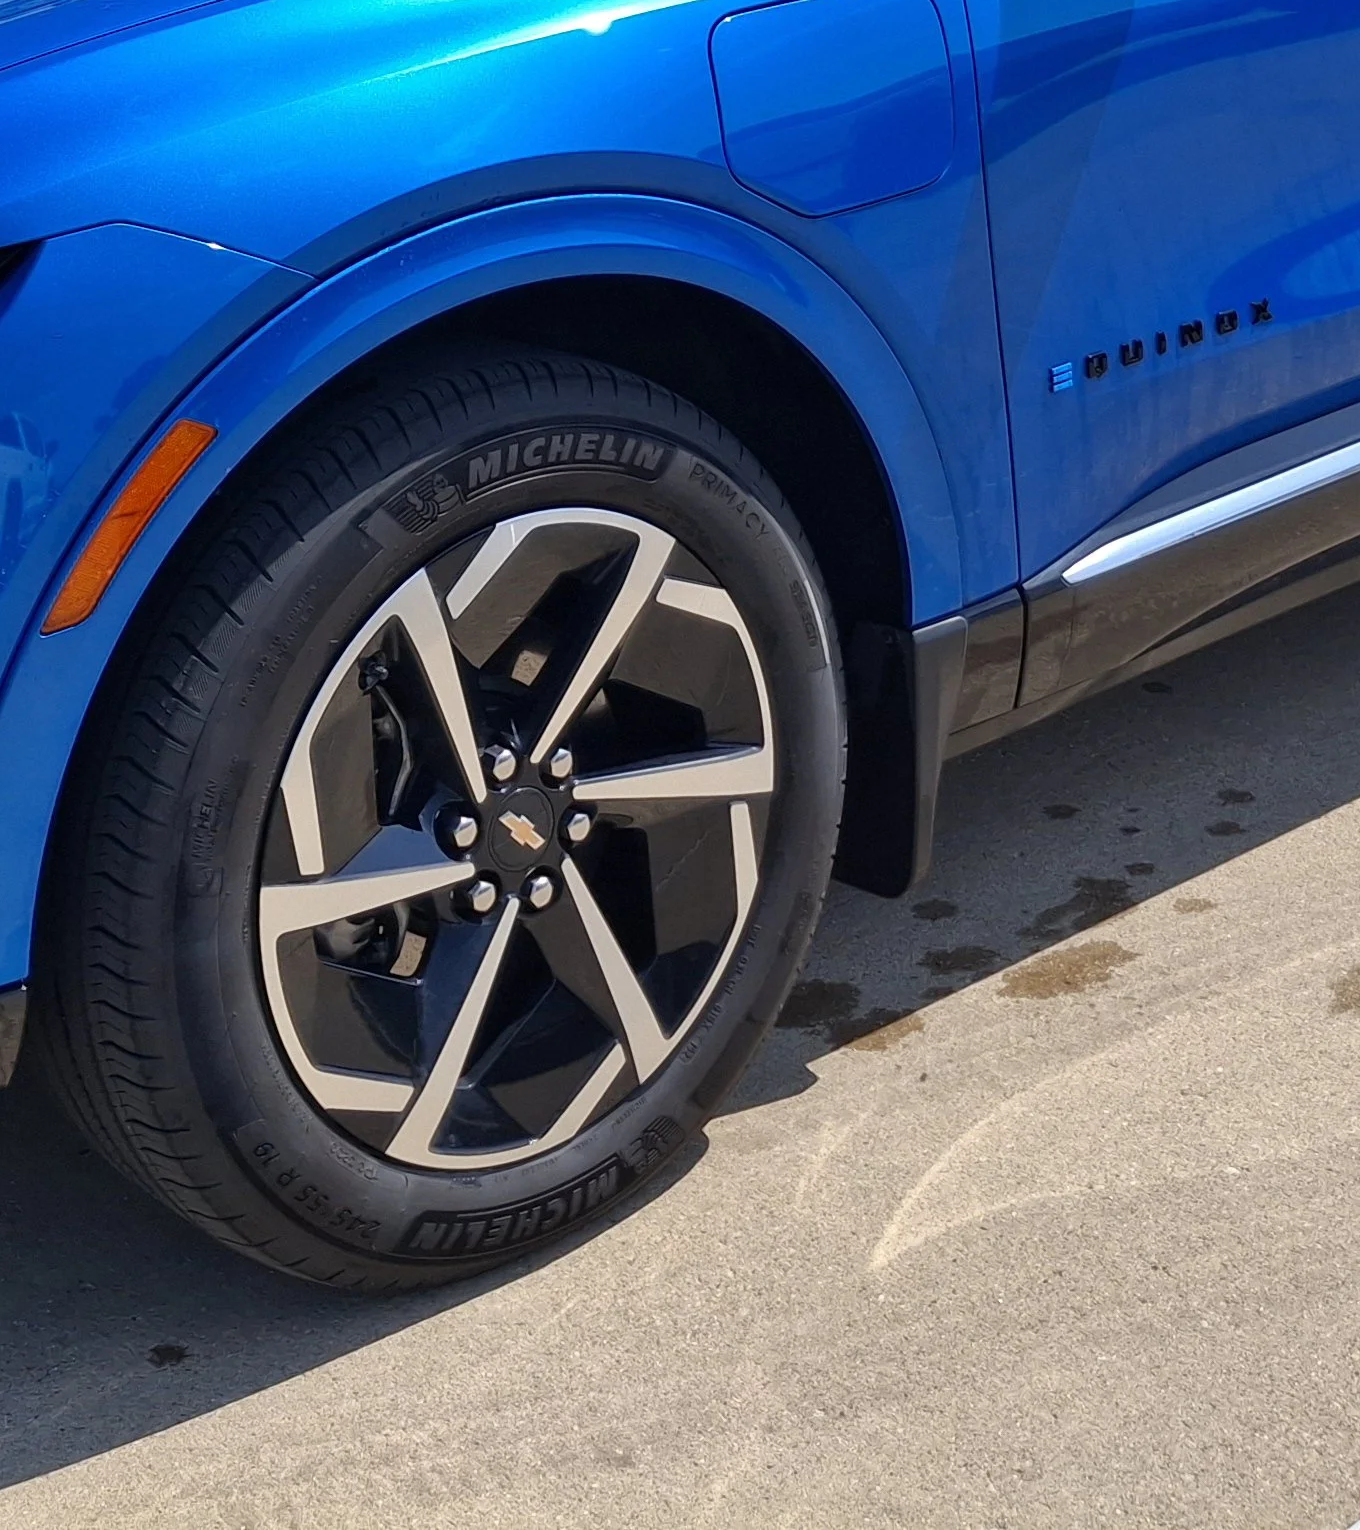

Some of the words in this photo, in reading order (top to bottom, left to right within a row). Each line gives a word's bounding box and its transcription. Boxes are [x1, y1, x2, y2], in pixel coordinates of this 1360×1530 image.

[1049, 297, 1273, 393] EQUINOX
[468, 433, 664, 489] MICHELIN
[689, 462, 769, 540] PRIMACY
[408, 1164, 618, 1250] MICHELIN
